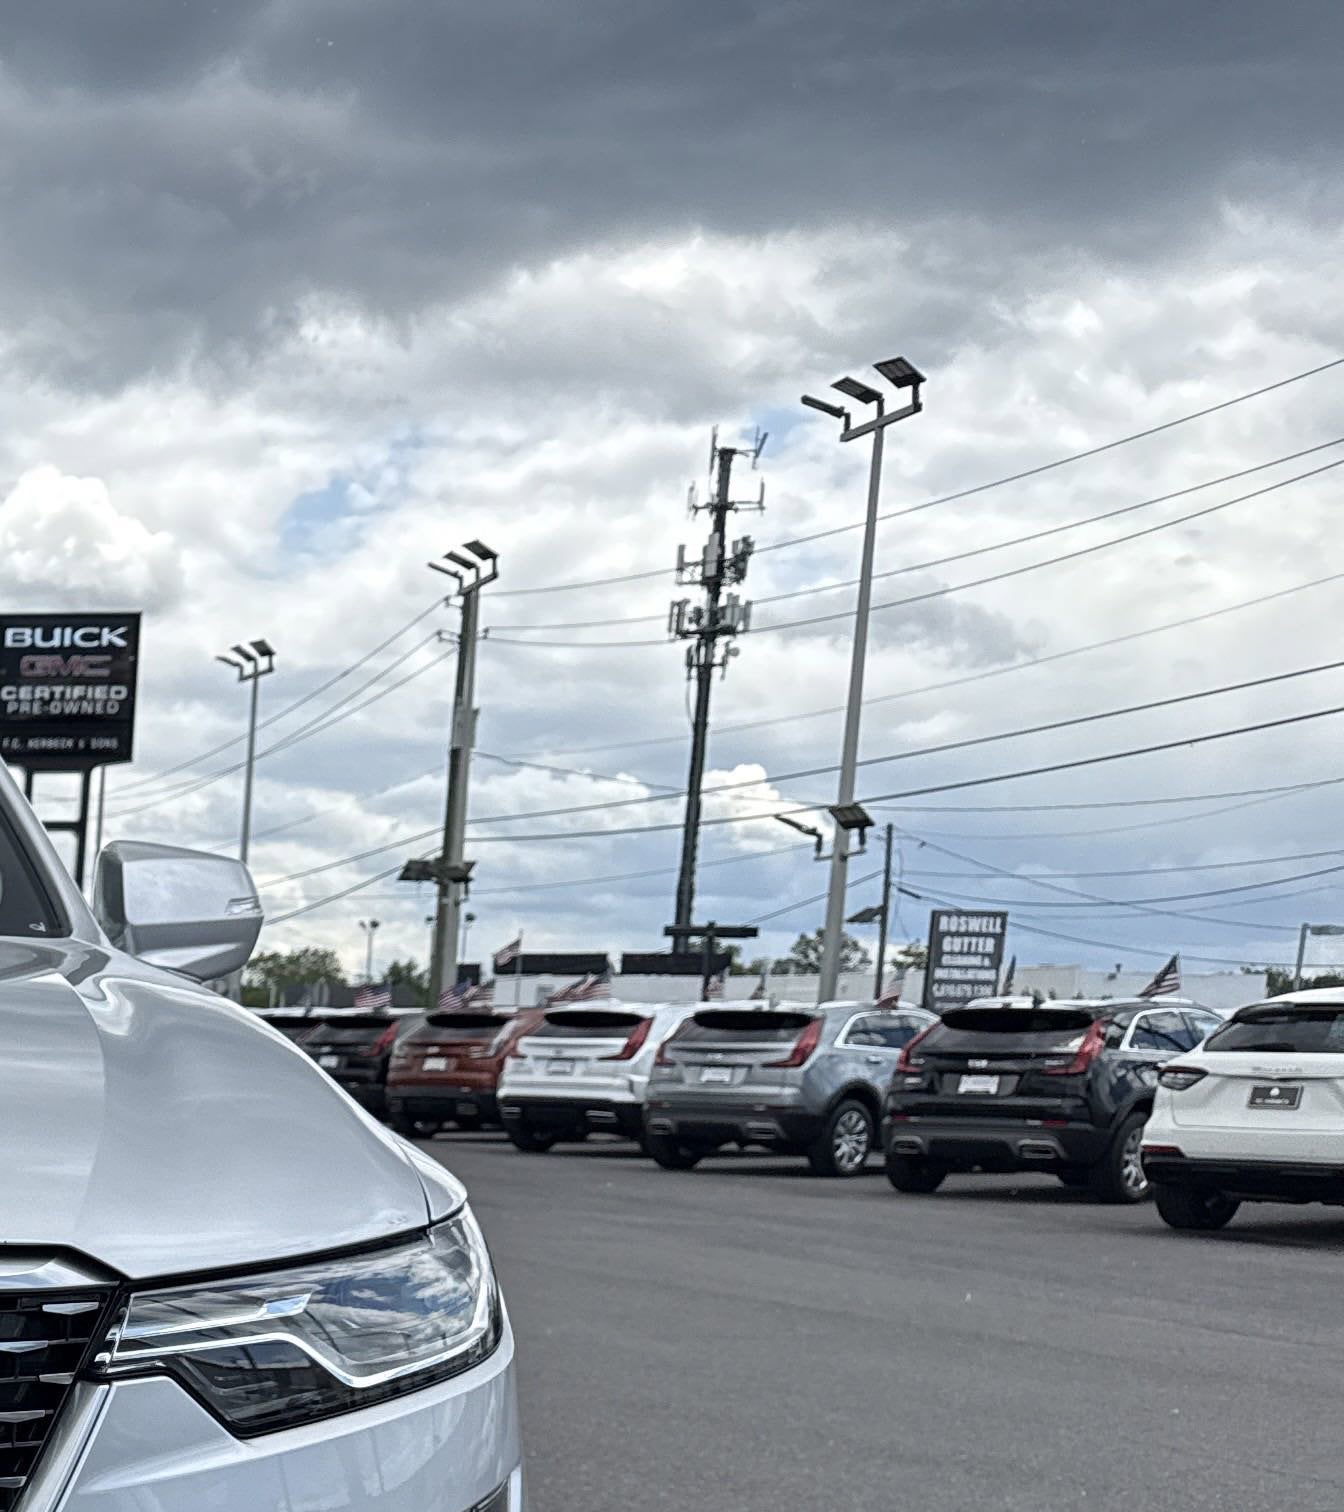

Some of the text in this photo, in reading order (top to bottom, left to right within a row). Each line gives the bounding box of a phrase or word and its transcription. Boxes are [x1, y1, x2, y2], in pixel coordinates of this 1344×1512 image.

[3, 626, 128, 648] BUICK
[19, 654, 113, 678] GMC
[0, 684, 128, 702] CERTIFIED
[6, 700, 120, 715] PRE-OWNED
[939, 915, 1002, 933] ROSWELL
[942, 936, 995, 953] GUTTER
